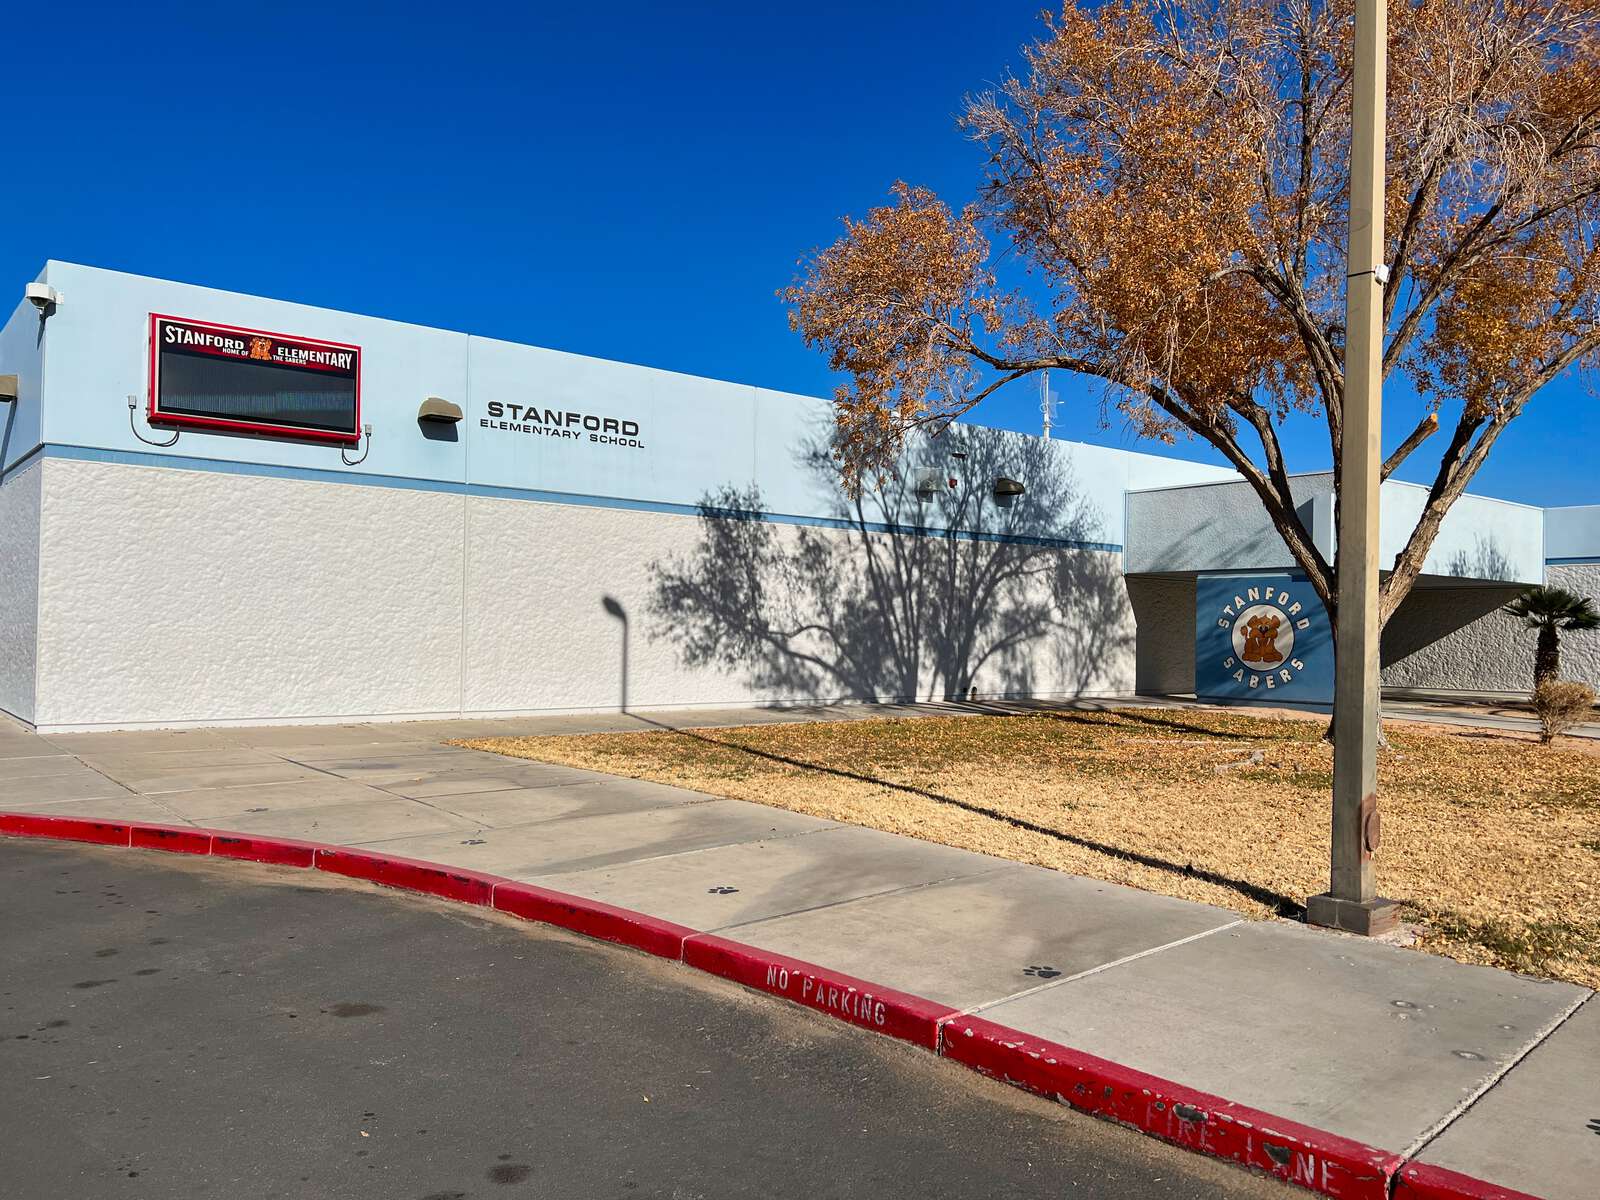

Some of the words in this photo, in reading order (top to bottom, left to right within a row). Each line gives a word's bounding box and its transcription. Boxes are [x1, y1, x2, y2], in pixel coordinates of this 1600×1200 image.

[165, 325, 245, 350] STANFORD
[277, 346, 353, 370] ELEMENTARY
[222, 347, 240, 355] HOME
[241, 349, 249, 357] OF
[272, 354, 284, 362] THE
[284, 356, 307, 365] SABERS
[479, 418, 581, 440] ELEMENTARY
[589, 433, 645, 449] SCHOOL
[487, 401, 640, 437] STANFORD
[1217, 586, 1310, 630] STANFORD
[1223, 656, 1304, 689] SABERS
[766, 964, 789, 991] NO
[802, 975, 886, 1026] PARKING
[1246, 1132, 1342, 1194] LNE
